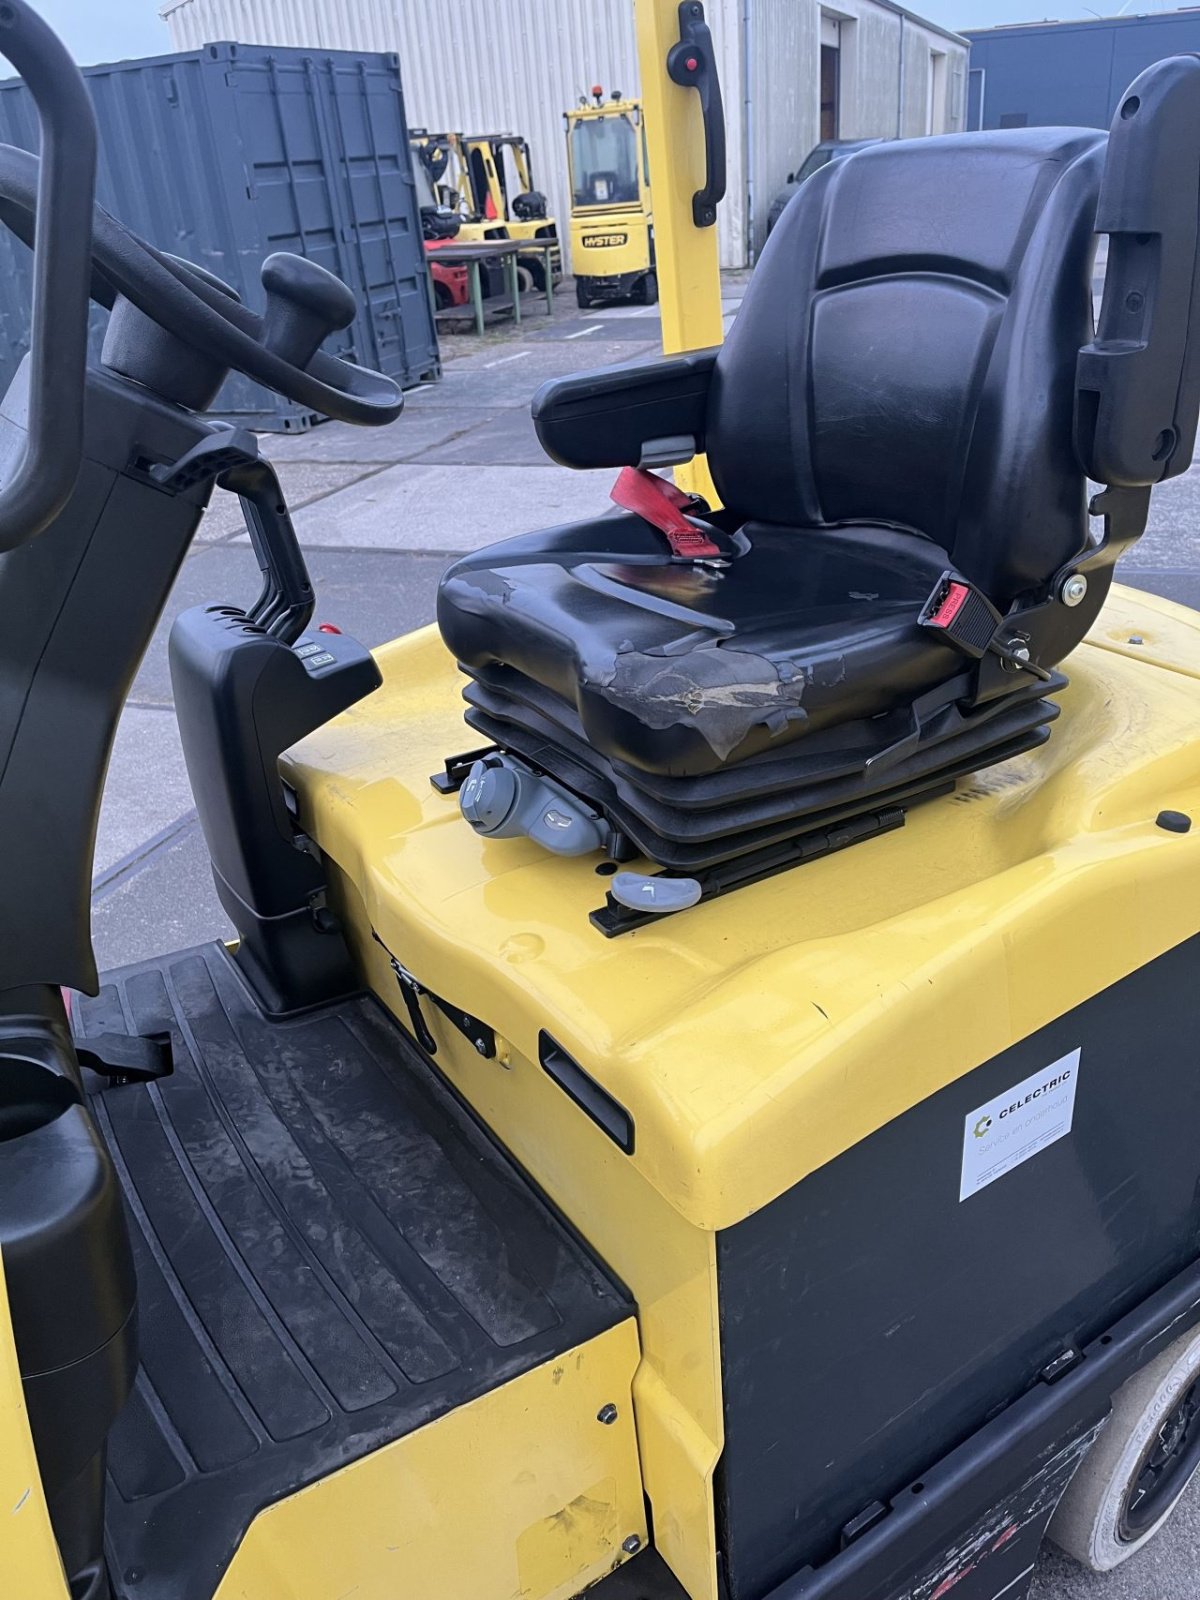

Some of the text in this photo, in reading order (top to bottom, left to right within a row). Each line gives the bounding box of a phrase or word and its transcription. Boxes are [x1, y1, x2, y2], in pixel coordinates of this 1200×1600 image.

[584, 235, 625, 247] HYSTER
[943, 592, 961, 619] PRESS
[999, 1070, 1071, 1120] CELECTRIC
